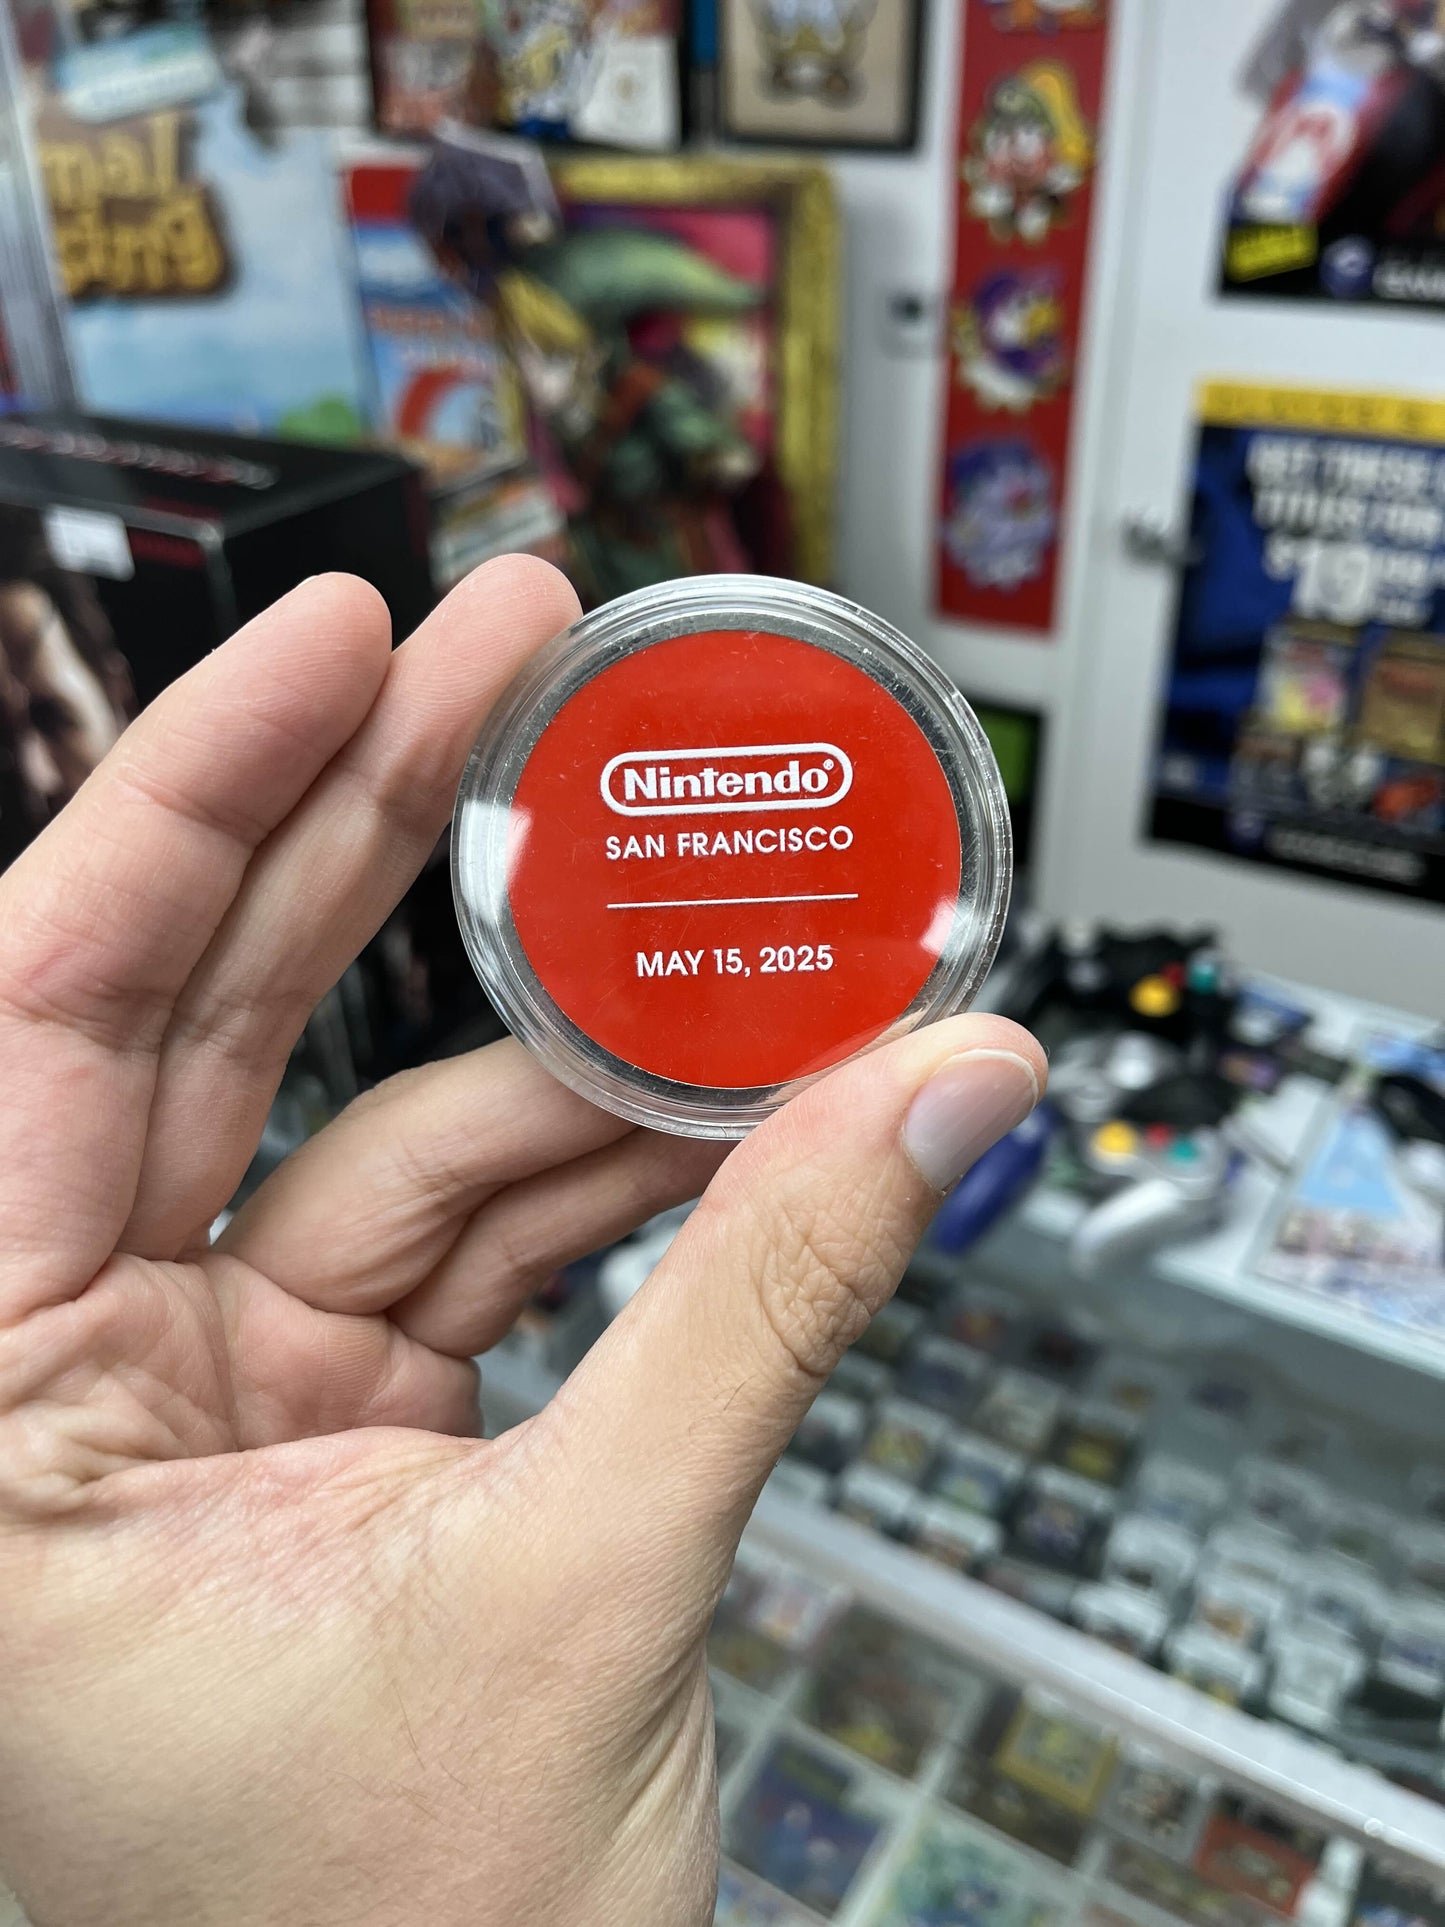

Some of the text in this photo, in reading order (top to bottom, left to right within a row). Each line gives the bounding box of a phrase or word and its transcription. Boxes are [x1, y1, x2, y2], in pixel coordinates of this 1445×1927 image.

[606, 825, 854, 860] SAN FRANCISCO
[636, 944, 833, 977] MAY 15, 2025
